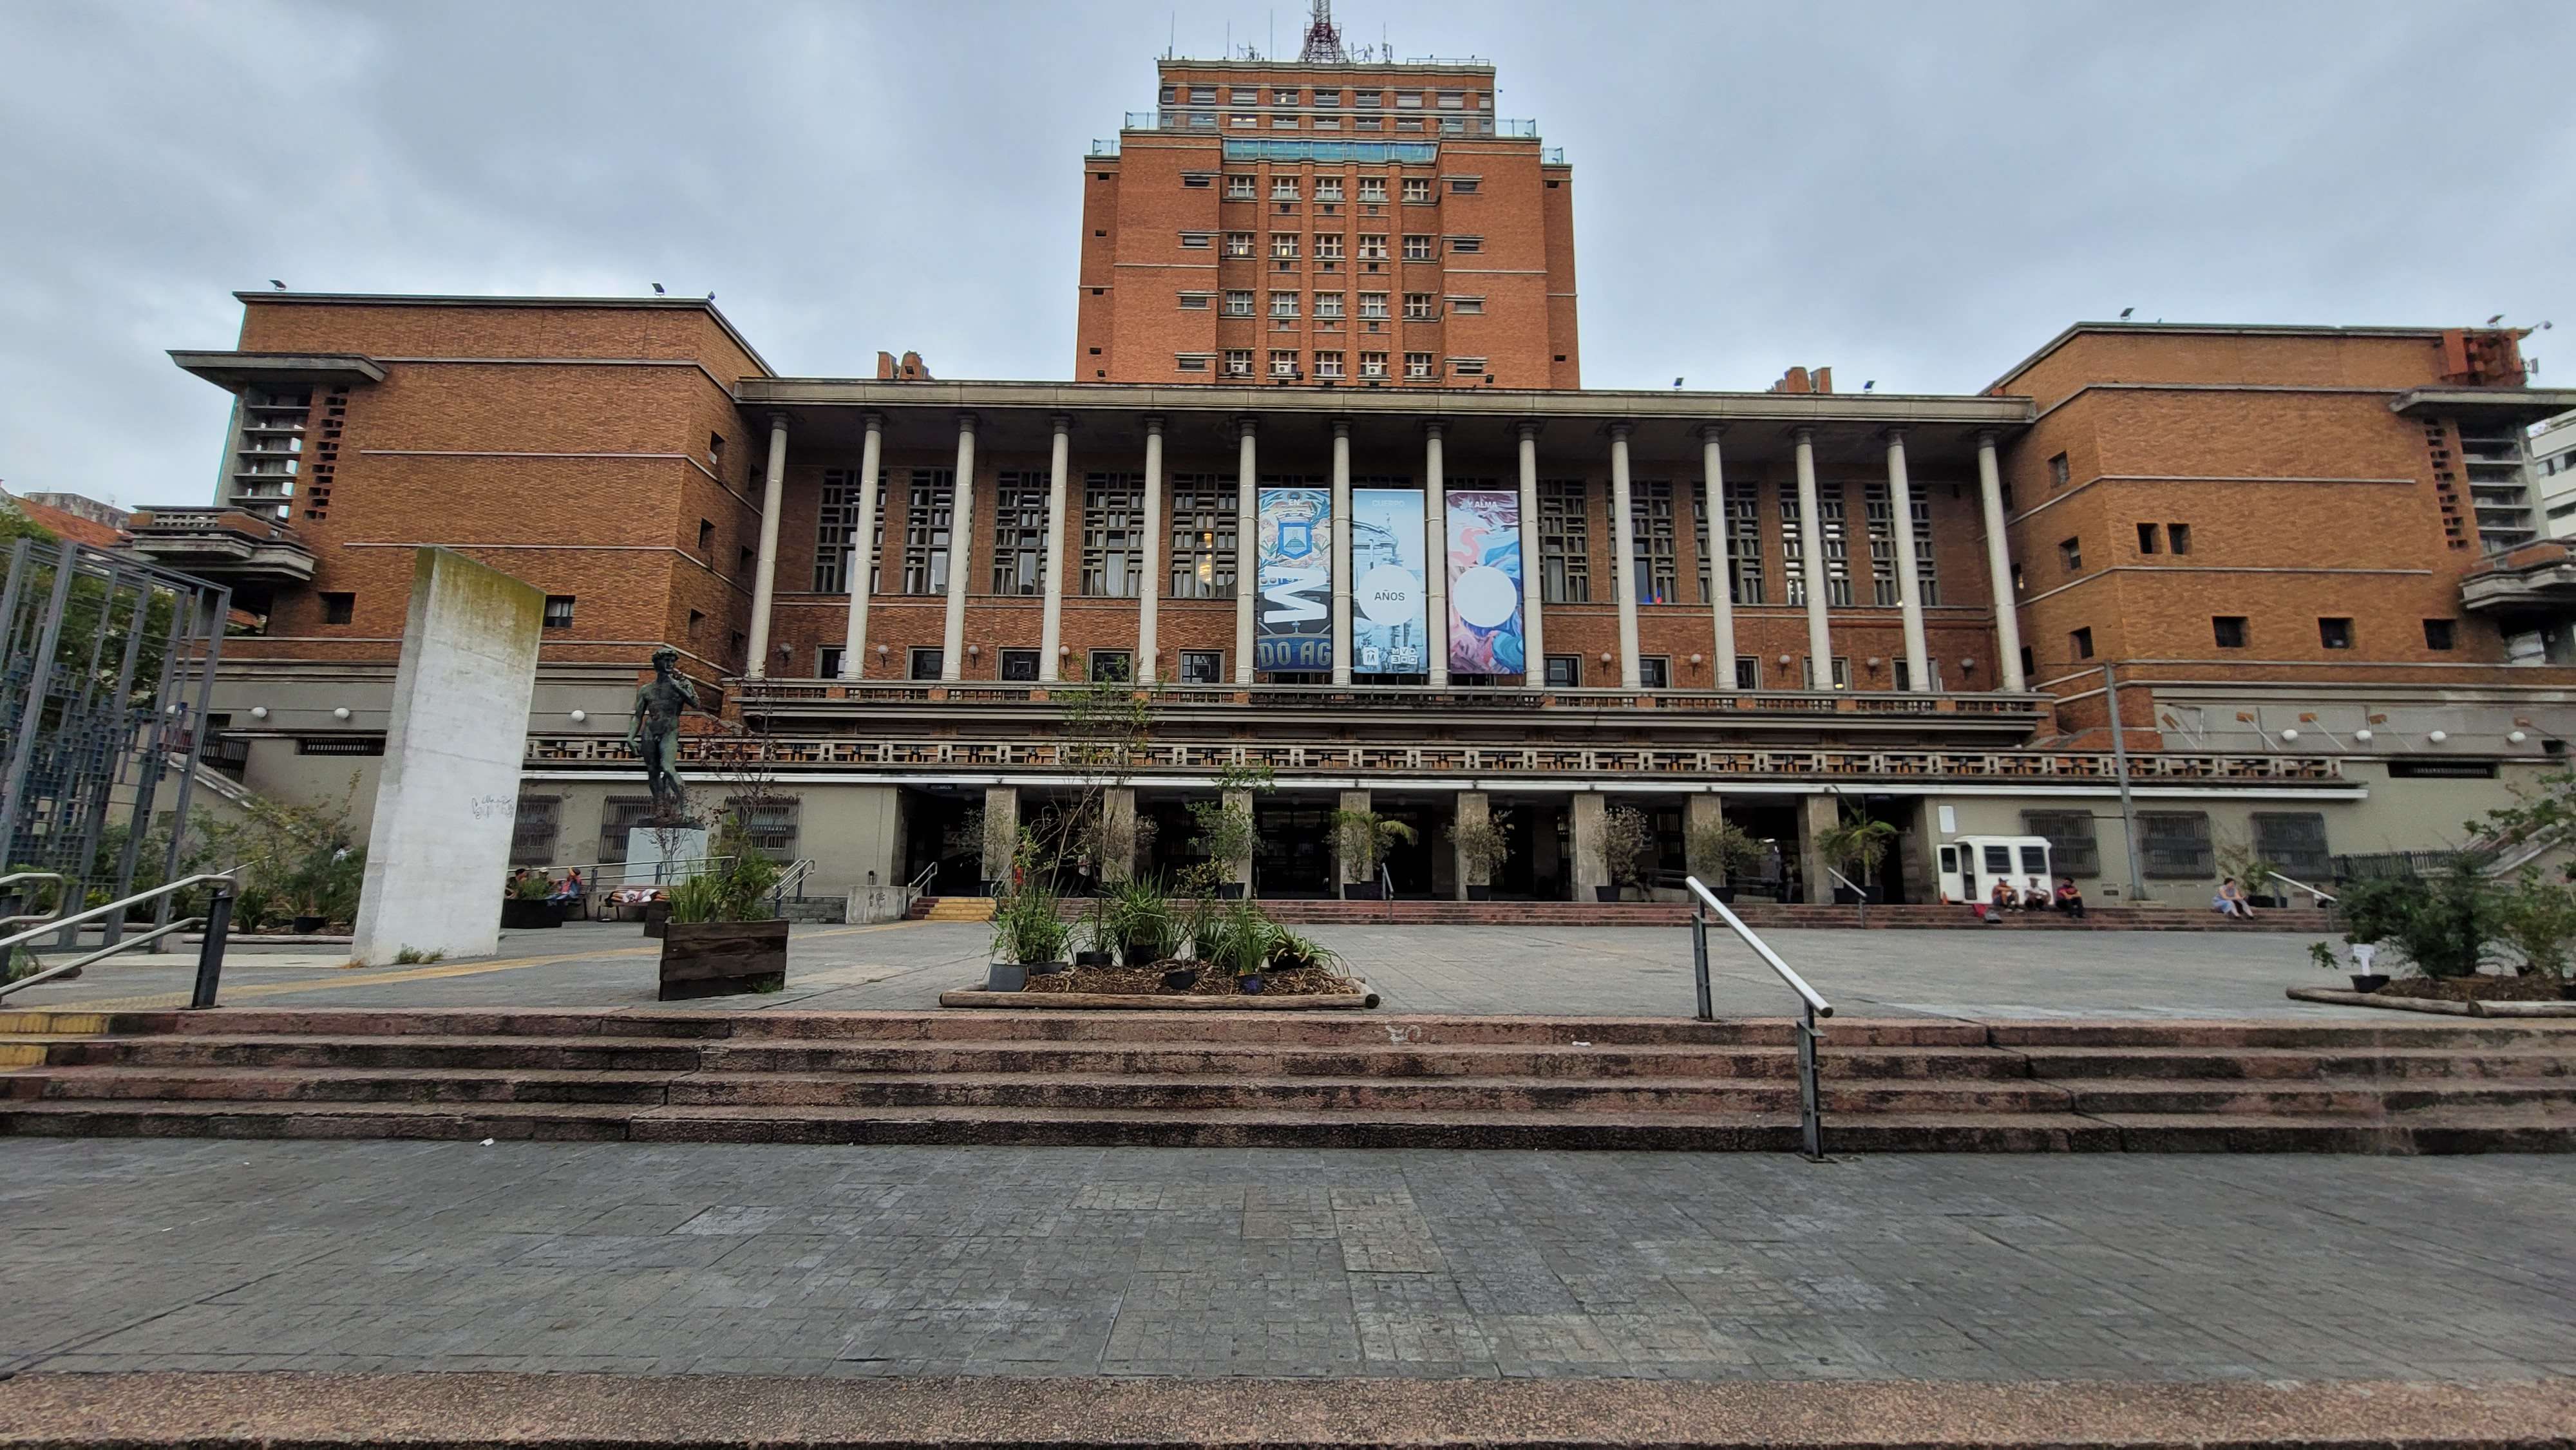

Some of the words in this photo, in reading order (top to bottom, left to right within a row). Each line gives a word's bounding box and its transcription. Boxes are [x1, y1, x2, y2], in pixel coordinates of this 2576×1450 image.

[1374, 589, 1405, 601] AÑOS
[1258, 641, 1291, 666] DO
[1300, 641, 1331, 666] AG
